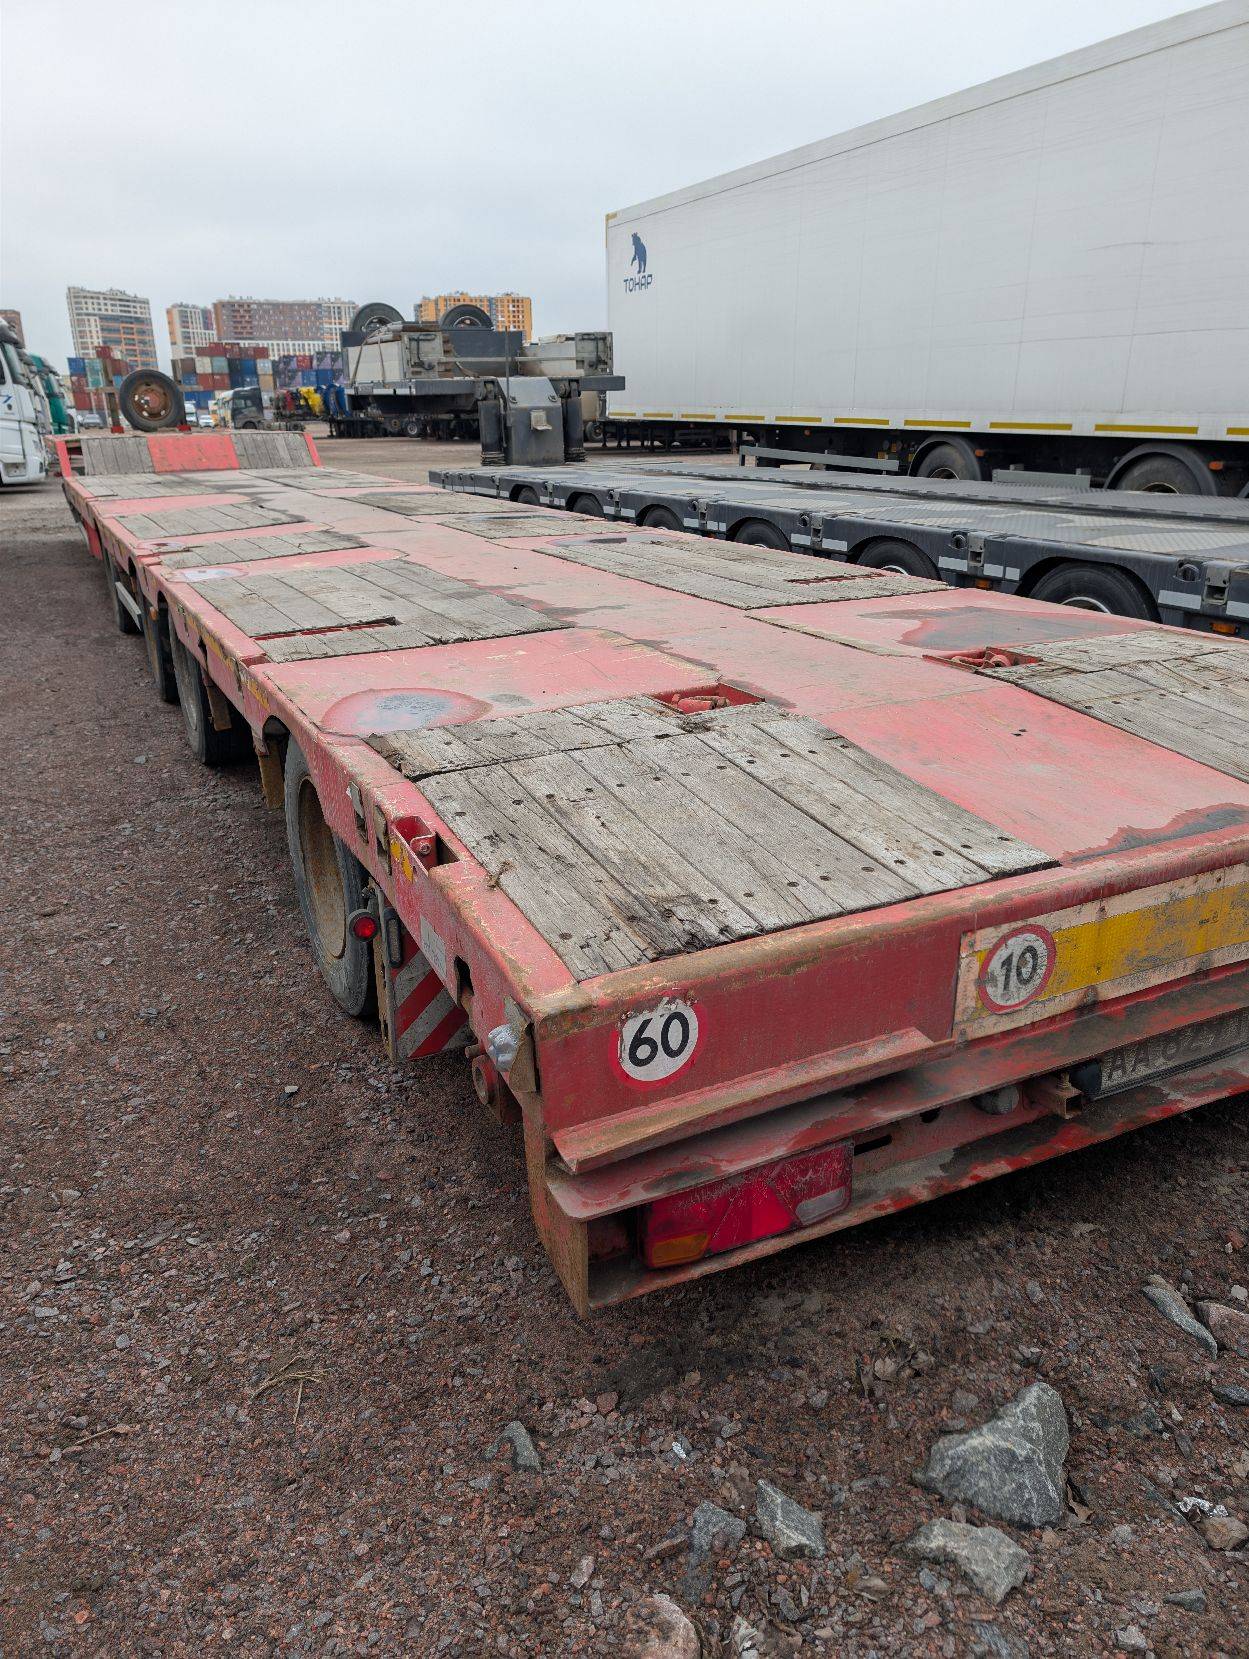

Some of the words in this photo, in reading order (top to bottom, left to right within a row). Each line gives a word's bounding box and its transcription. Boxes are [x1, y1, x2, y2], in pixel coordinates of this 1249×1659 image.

[623, 274, 653, 294] ТОНАР
[1001, 945, 1038, 992] 10
[629, 1011, 690, 1067] 60
